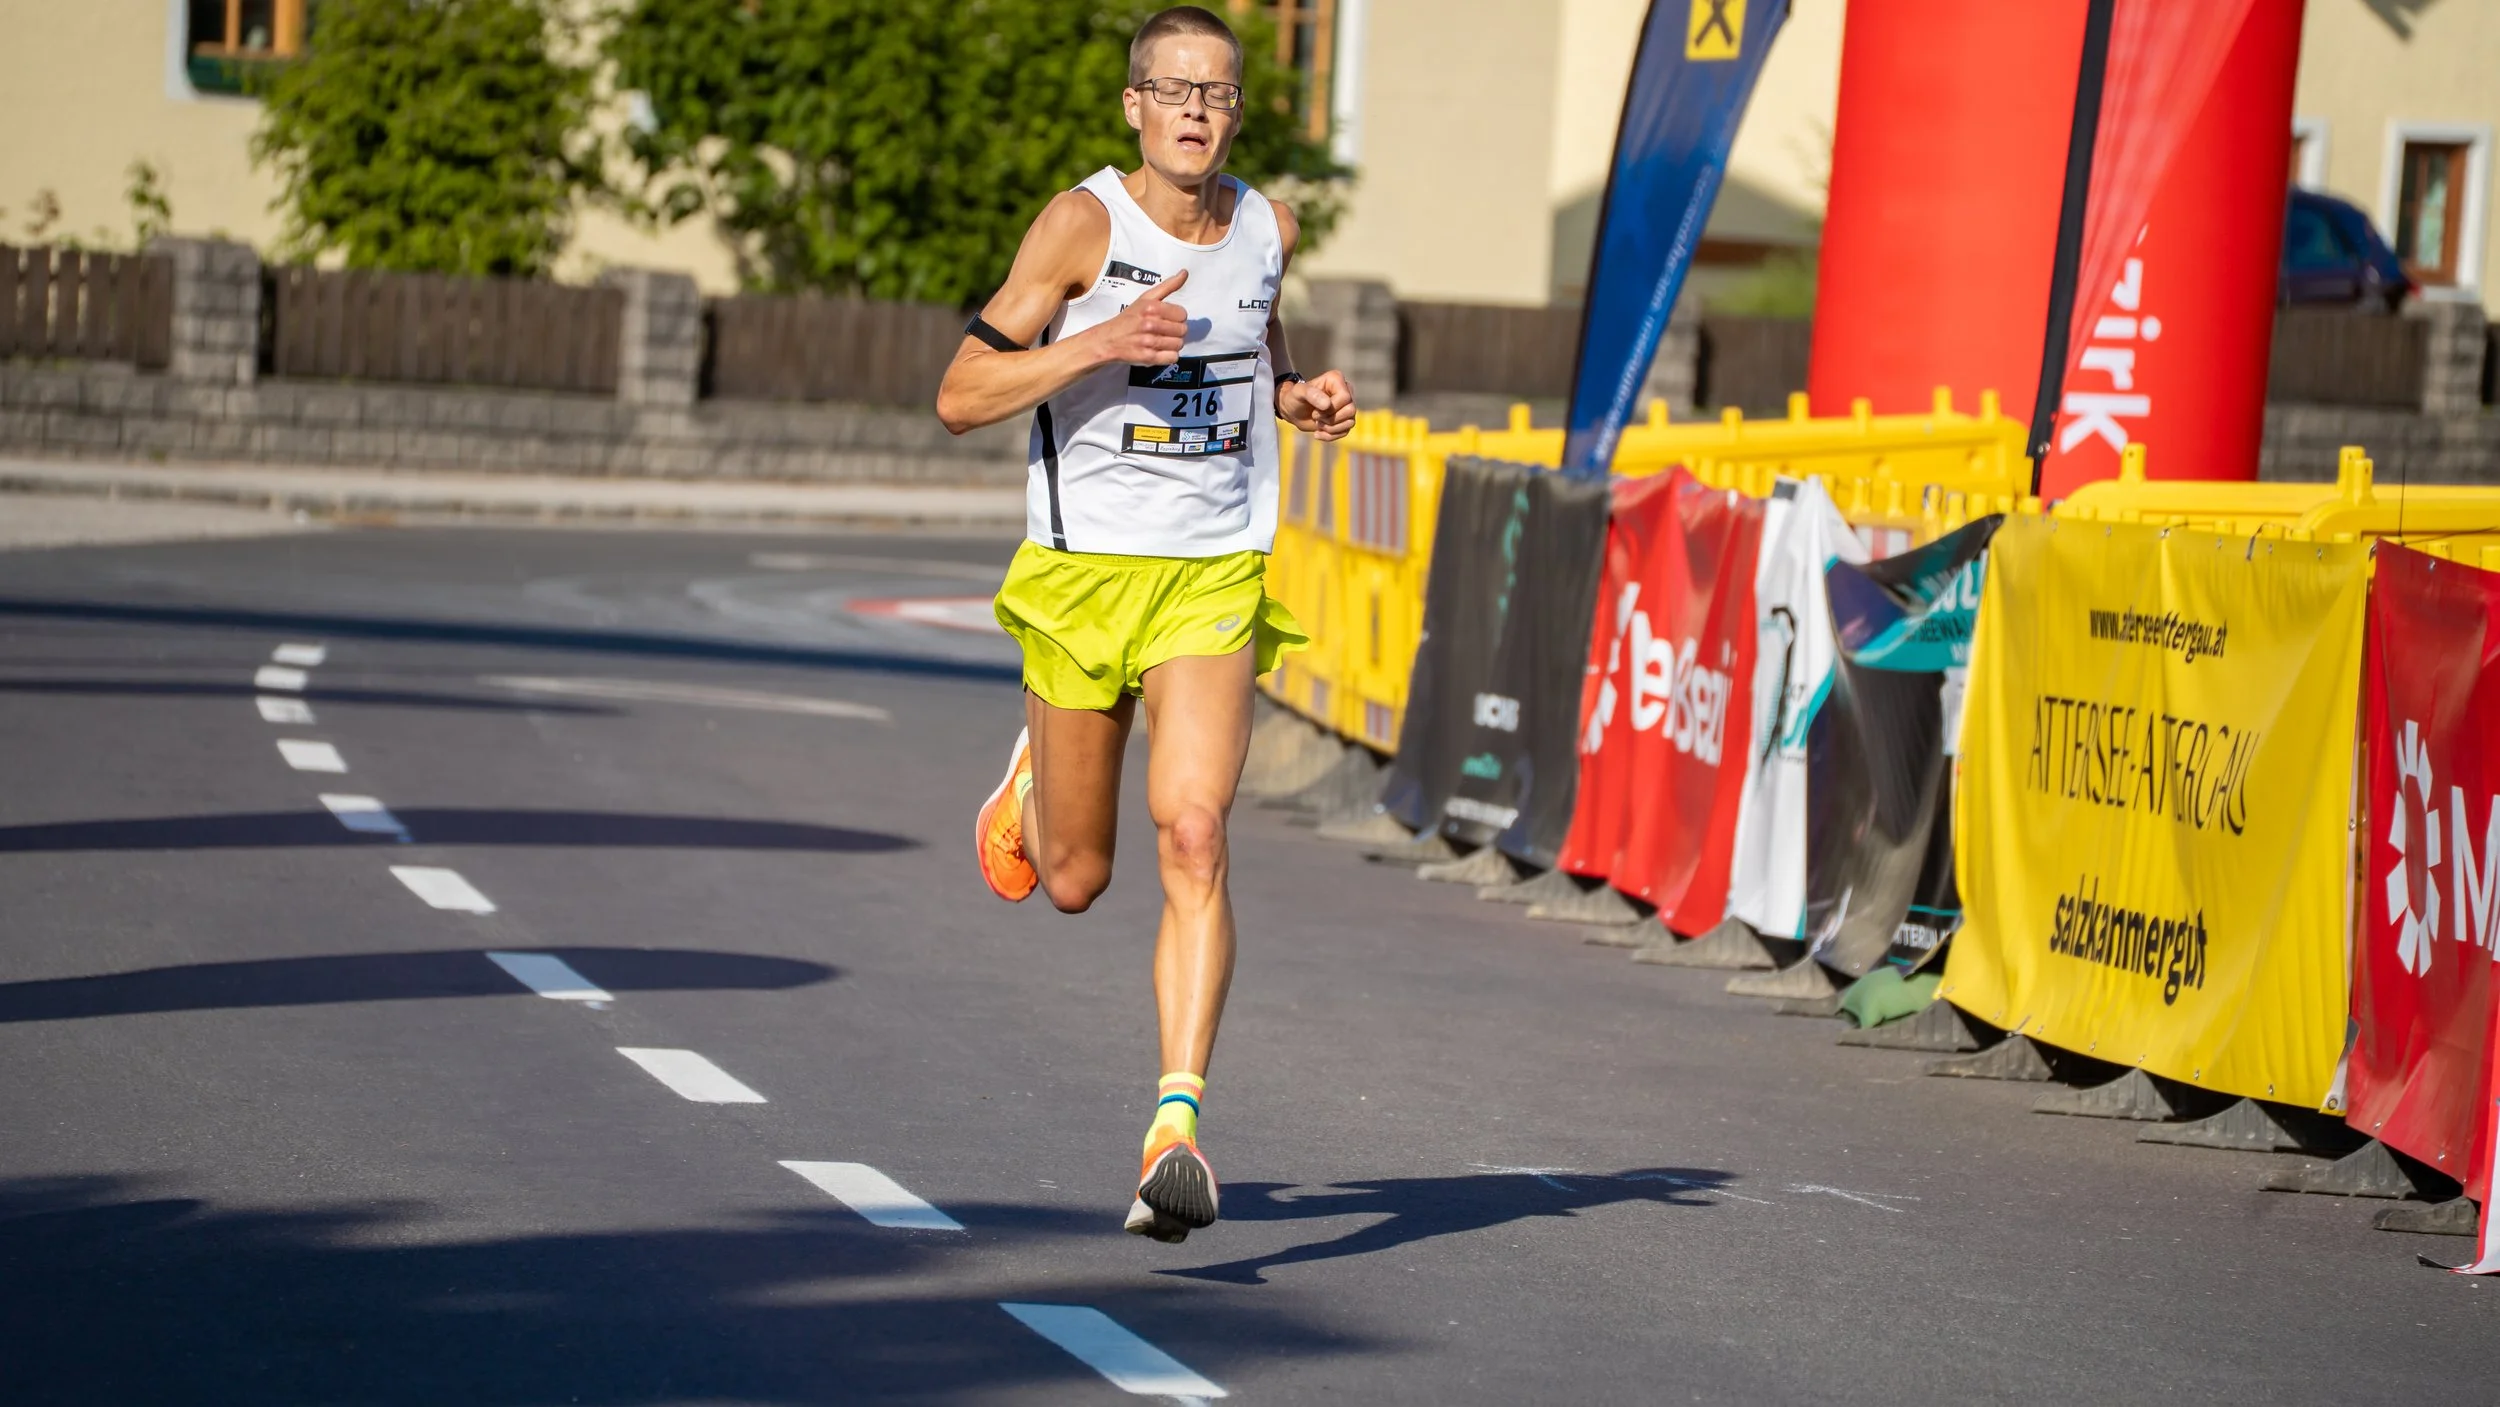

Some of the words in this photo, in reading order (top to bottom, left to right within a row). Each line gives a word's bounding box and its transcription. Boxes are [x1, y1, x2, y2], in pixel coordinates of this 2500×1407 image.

[1171, 390, 1218, 418] 216
[2059, 222, 2162, 457] zirk
[2452, 785, 2500, 962] M
